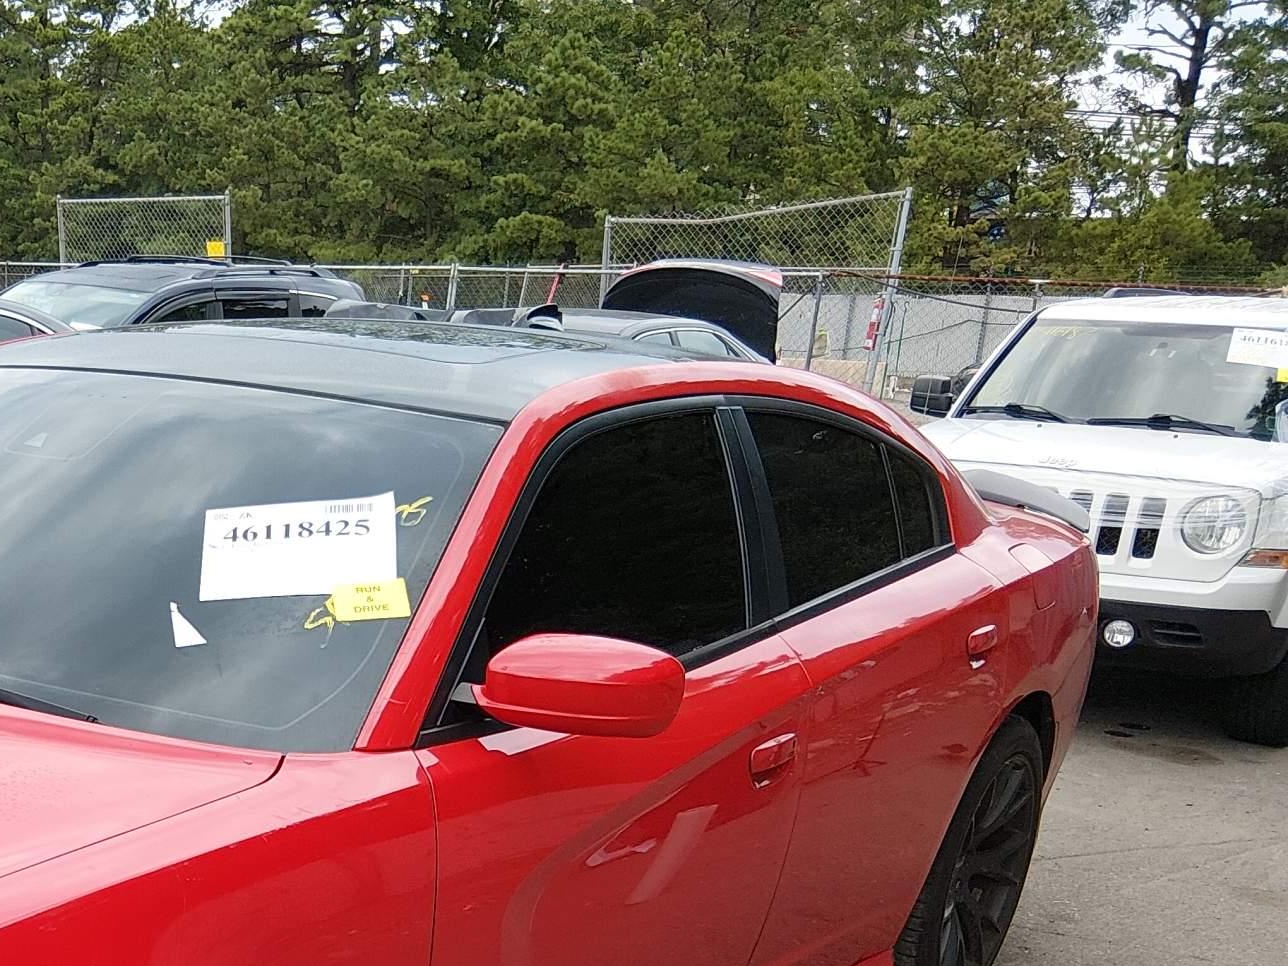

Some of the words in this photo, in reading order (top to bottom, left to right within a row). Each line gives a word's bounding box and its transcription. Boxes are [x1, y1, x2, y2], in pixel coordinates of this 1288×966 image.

[223, 518, 371, 543] 46118425
[354, 585, 381, 594] RUN
[353, 603, 390, 613] DRIVE
